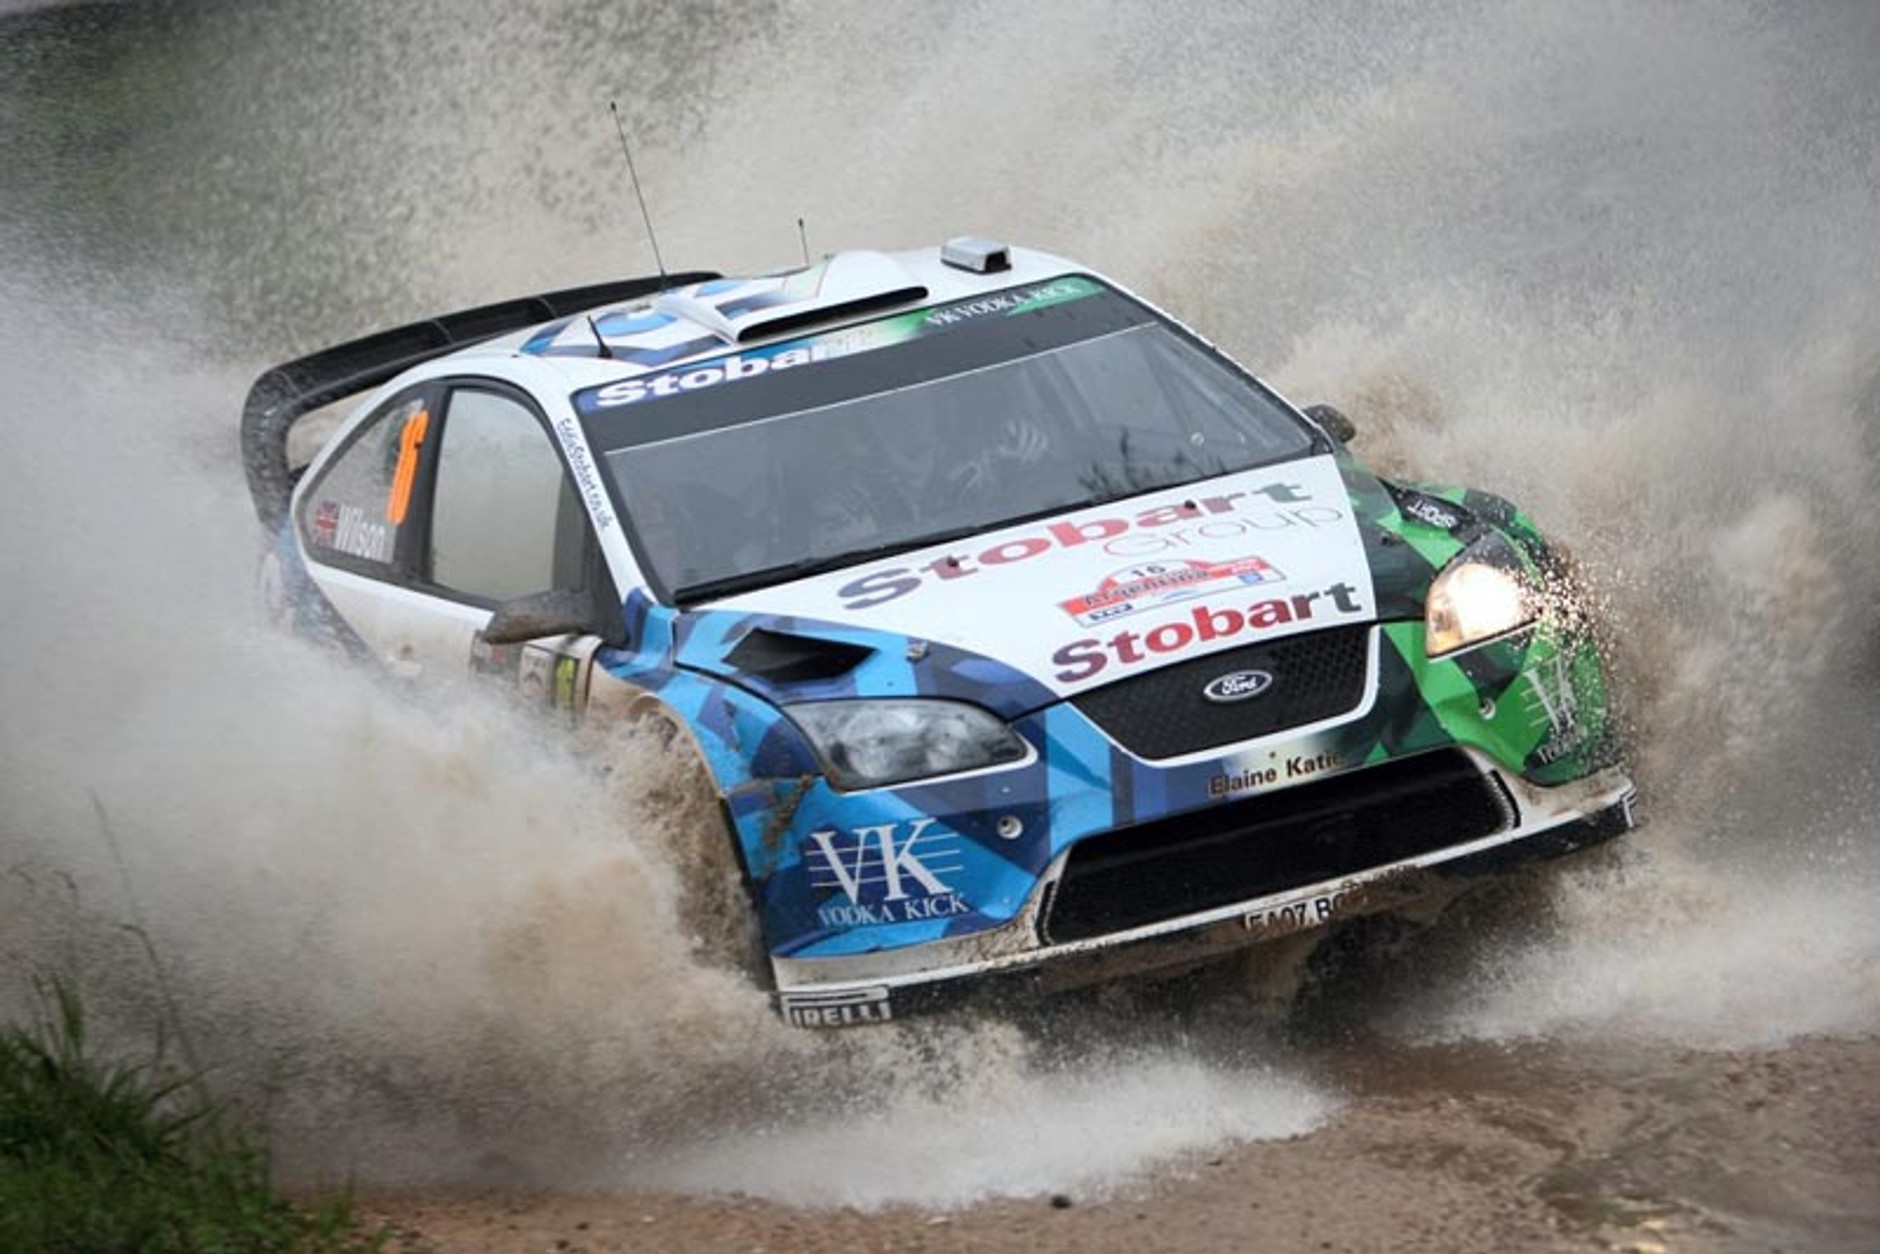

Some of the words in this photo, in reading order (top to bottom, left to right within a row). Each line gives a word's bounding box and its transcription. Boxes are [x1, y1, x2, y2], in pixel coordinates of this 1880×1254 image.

[335, 505, 396, 564] Wilson
[836, 482, 1314, 610] Stobart
[1101, 505, 1344, 558] Group
[1085, 567, 1211, 607] Argentina
[1130, 564, 1167, 578] 16
[1051, 582, 1363, 684] Stobart
[1209, 767, 1278, 796] Elaine
[1285, 751, 1345, 779] Katie
[809, 816, 955, 905] VK
[817, 902, 896, 928] VODKA
[904, 892, 970, 921] KICK
